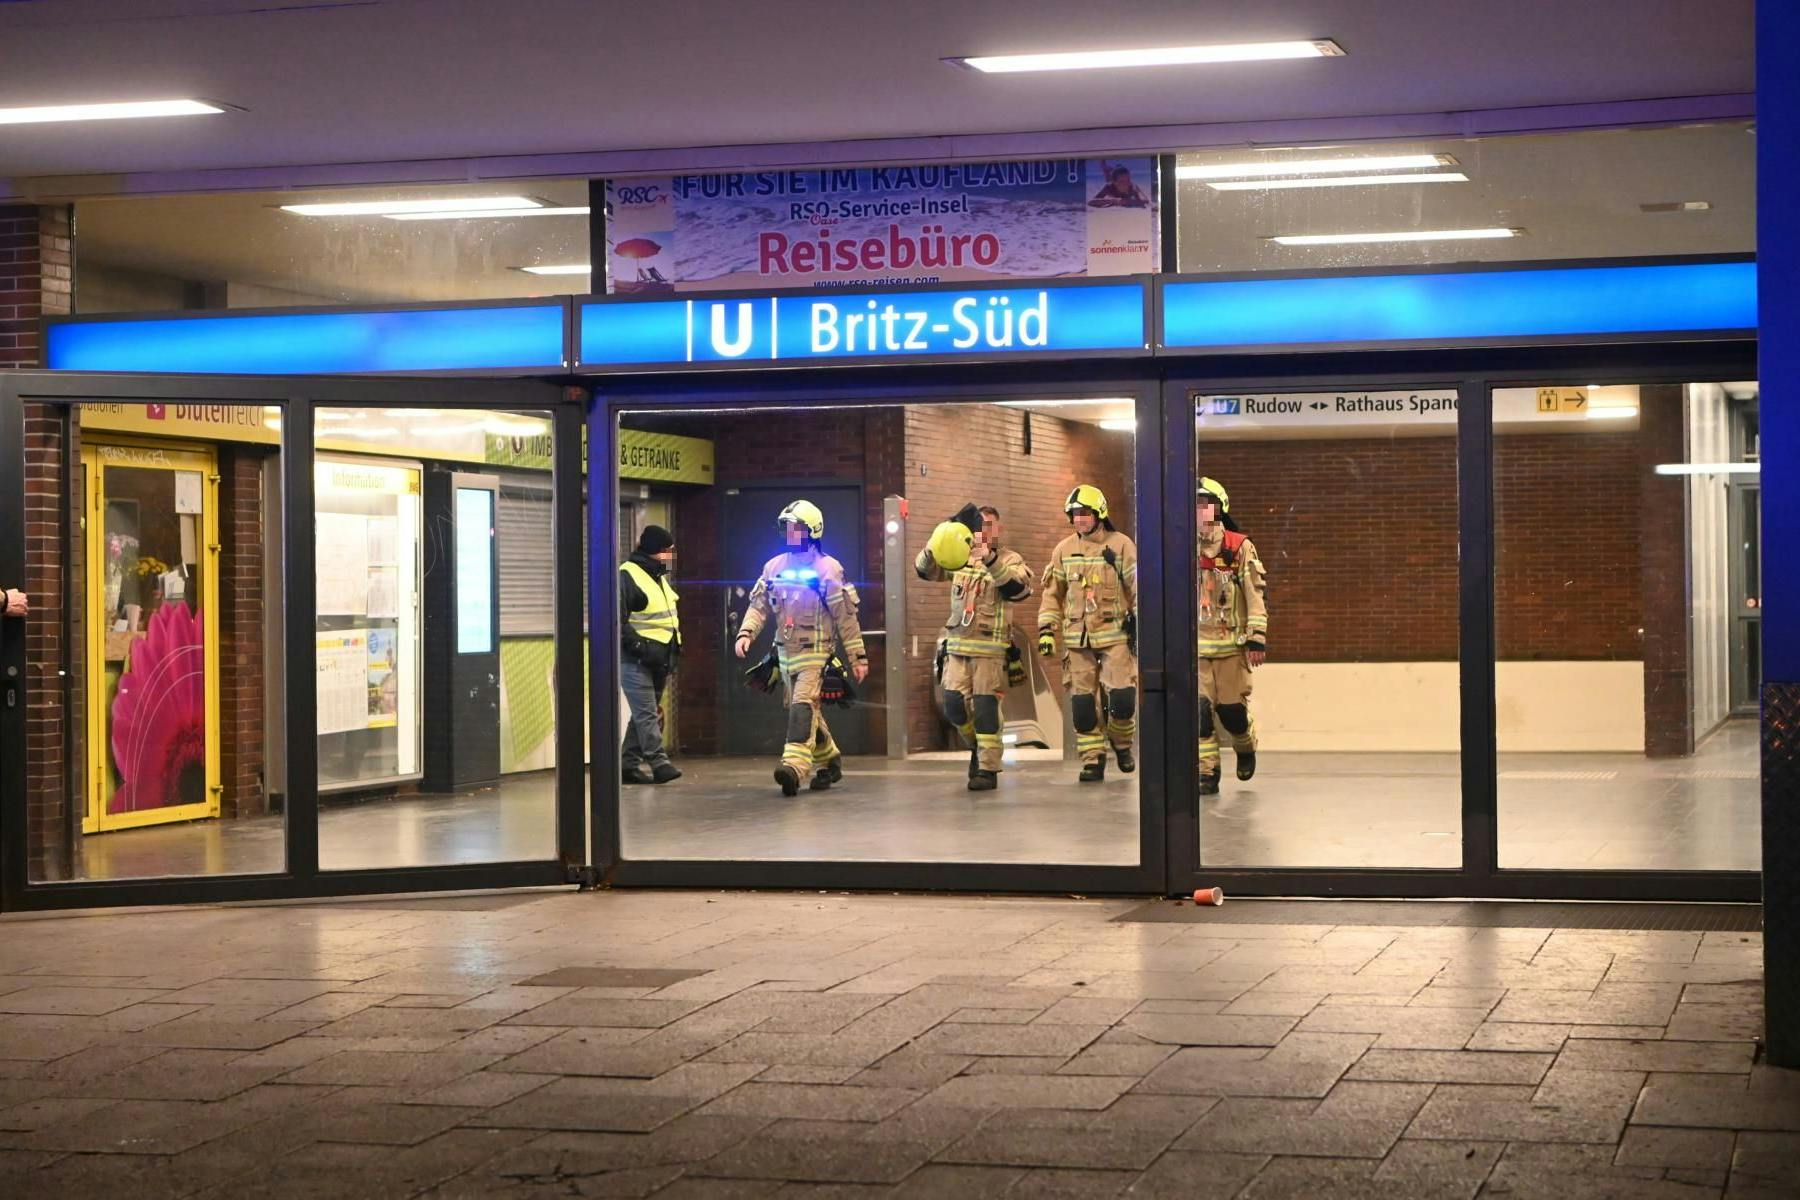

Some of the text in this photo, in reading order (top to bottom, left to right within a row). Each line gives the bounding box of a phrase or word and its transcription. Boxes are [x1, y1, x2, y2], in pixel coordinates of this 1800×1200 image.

[756, 171, 806, 195] SIE
[820, 169, 858, 193] IM
[871, 160, 1056, 190] KAUFLAND
[790, 196, 969, 220] RSO-Service-Insel
[759, 224, 1000, 274] Reisebüro
[711, 292, 1048, 358] U Britz-Süd
[1215, 399, 1238, 413] U7
[1246, 397, 1302, 414] Rudow
[1336, 394, 1404, 412] Rathaus
[620, 444, 628, 464] &
[631, 443, 681, 471] GETRÄNKE
